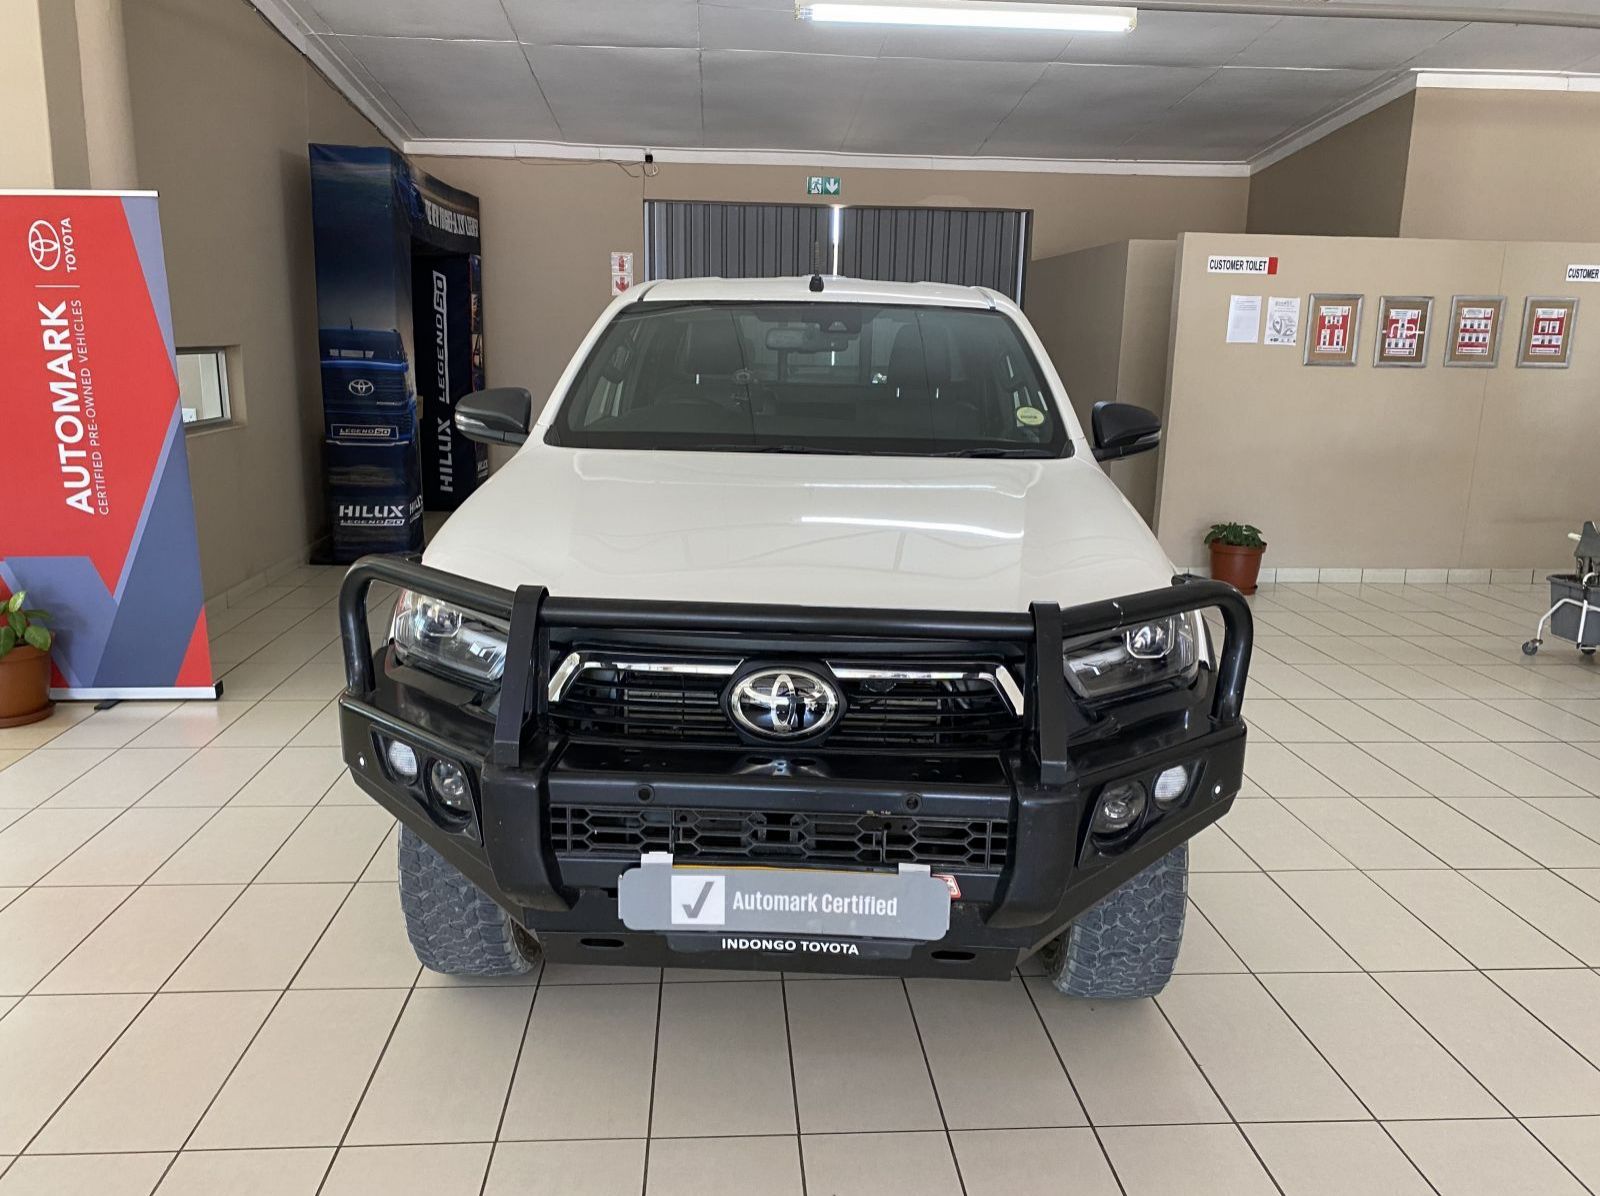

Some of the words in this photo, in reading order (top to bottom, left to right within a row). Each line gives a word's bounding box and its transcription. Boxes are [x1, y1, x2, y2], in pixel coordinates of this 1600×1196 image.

[60, 216, 78, 273] TOYOTA
[1209, 259, 1244, 270] CUSTOMER
[1246, 260, 1267, 272] TOILET
[1567, 268, 1600, 279] CUSTOMER
[70, 299, 89, 362] VEHICLES
[37, 300, 95, 515] AUTOMARK
[80, 368, 100, 446] PRE-OWNED
[92, 450, 110, 515] CERTIFIED
[436, 416, 454, 492] HILUX
[339, 504, 404, 518] HILUX
[732, 890, 818, 914] Automark
[821, 893, 898, 917] Certified
[721, 938, 797, 952] INDONGO
[800, 941, 860, 956] TOYOTA
